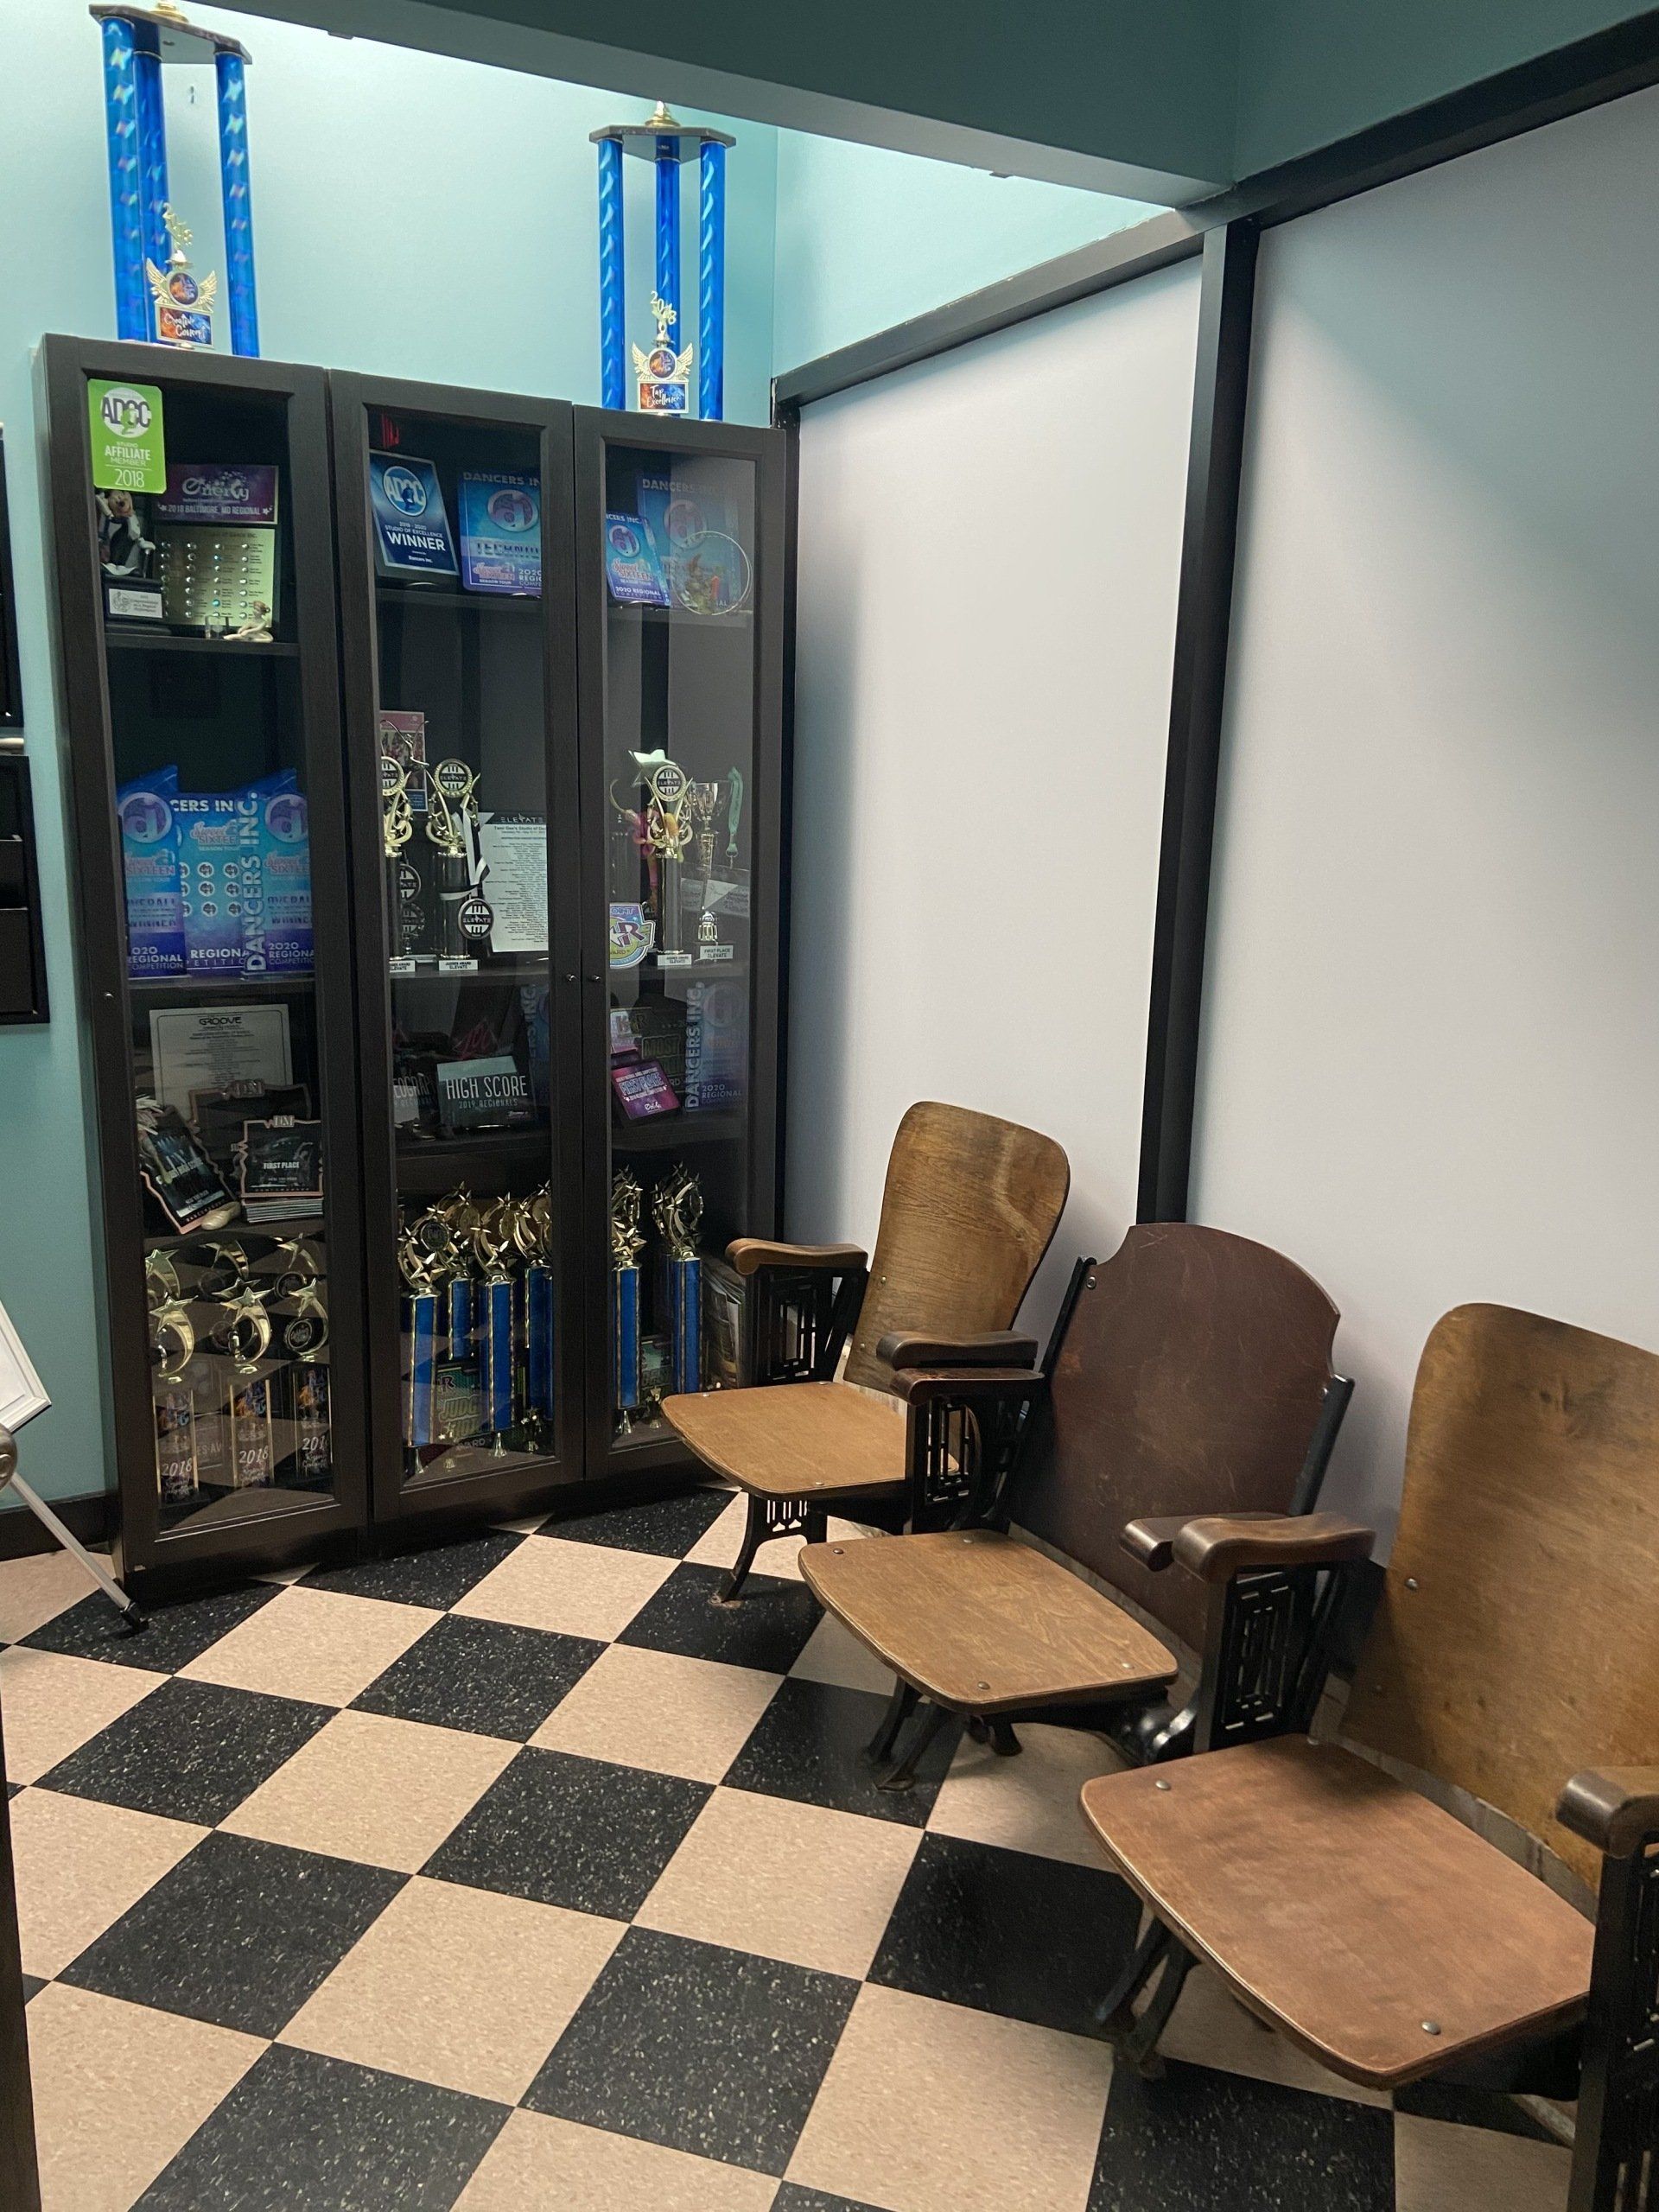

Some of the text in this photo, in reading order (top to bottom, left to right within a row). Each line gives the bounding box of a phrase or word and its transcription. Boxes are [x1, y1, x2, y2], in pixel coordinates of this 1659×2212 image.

[650, 385, 664, 400] Tap
[105, 445, 151, 461] AFFILIATE
[111, 457, 147, 467] MEMBER
[115, 468, 144, 487] 2018
[463, 472, 525, 485] DANCERS
[232, 506, 261, 516] REGIONAL
[412, 529, 443, 538] EXCELLENCE
[386, 531, 446, 551] WINNER
[632, 588, 661, 596] REGIONAL
[238, 791, 259, 845] INC.
[241, 855, 266, 971] DANCERS
[462, 915, 492, 924] ELEVATE
[269, 942, 299, 950] 2020
[199, 1017, 242, 1026] GROOVE
[685, 1026, 701, 1109] DANCERS
[446, 1075, 528, 1100] HIGH SCORE
[702, 1084, 726, 1092] 2020
[702, 1090, 742, 1098] REGIONAL
[458, 1098, 518, 1109] 2019 REGIONALS
[264, 1161, 281, 1170] FIRST
[238, 1445, 269, 1465] 2018
[161, 1457, 193, 1477] 2018
